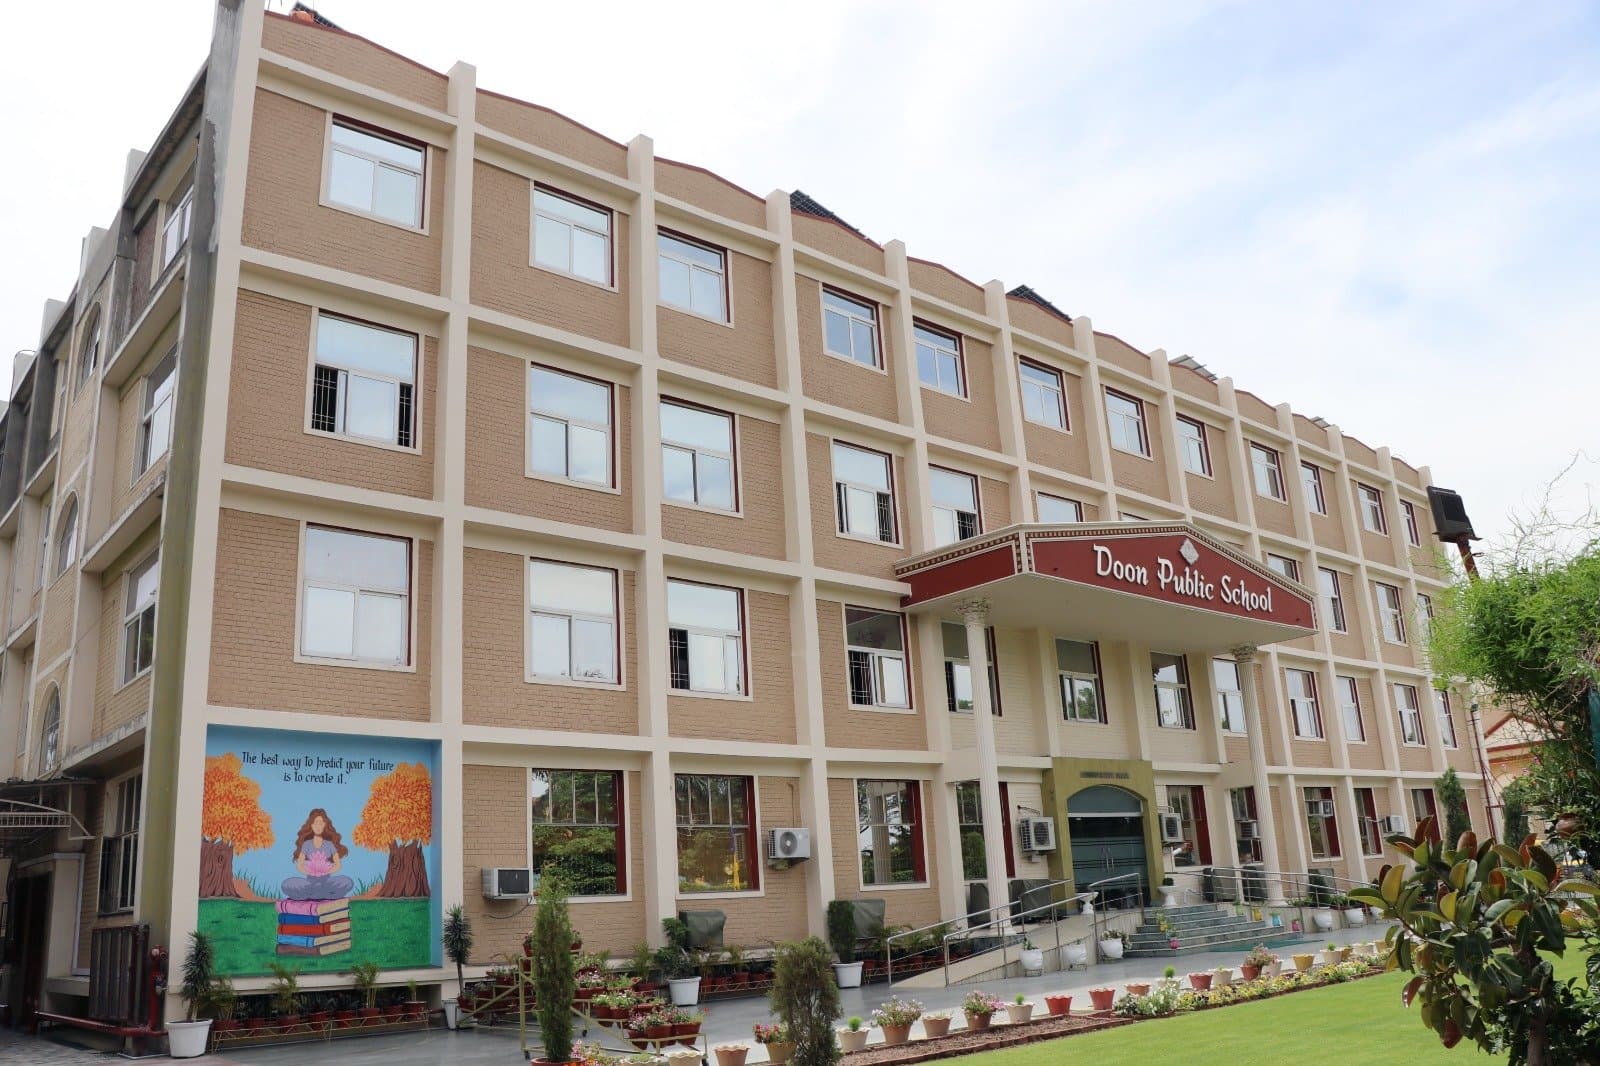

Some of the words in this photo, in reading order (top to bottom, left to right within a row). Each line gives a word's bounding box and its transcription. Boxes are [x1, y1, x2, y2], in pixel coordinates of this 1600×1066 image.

[1093, 543, 1149, 586] Doon
[1157, 555, 1215, 600] Public
[1220, 574, 1273, 613] School
[242, 751, 257, 764] The
[261, 752, 278, 765] best
[282, 758, 302, 770] way
[305, 755, 314, 767] to
[316, 756, 344, 770] predict
[345, 760, 365, 774] your
[369, 757, 394, 771] future
[283, 771, 292, 782] is
[294, 770, 303, 782] to
[305, 773, 334, 784] create
[337, 773, 347, 785] it.
